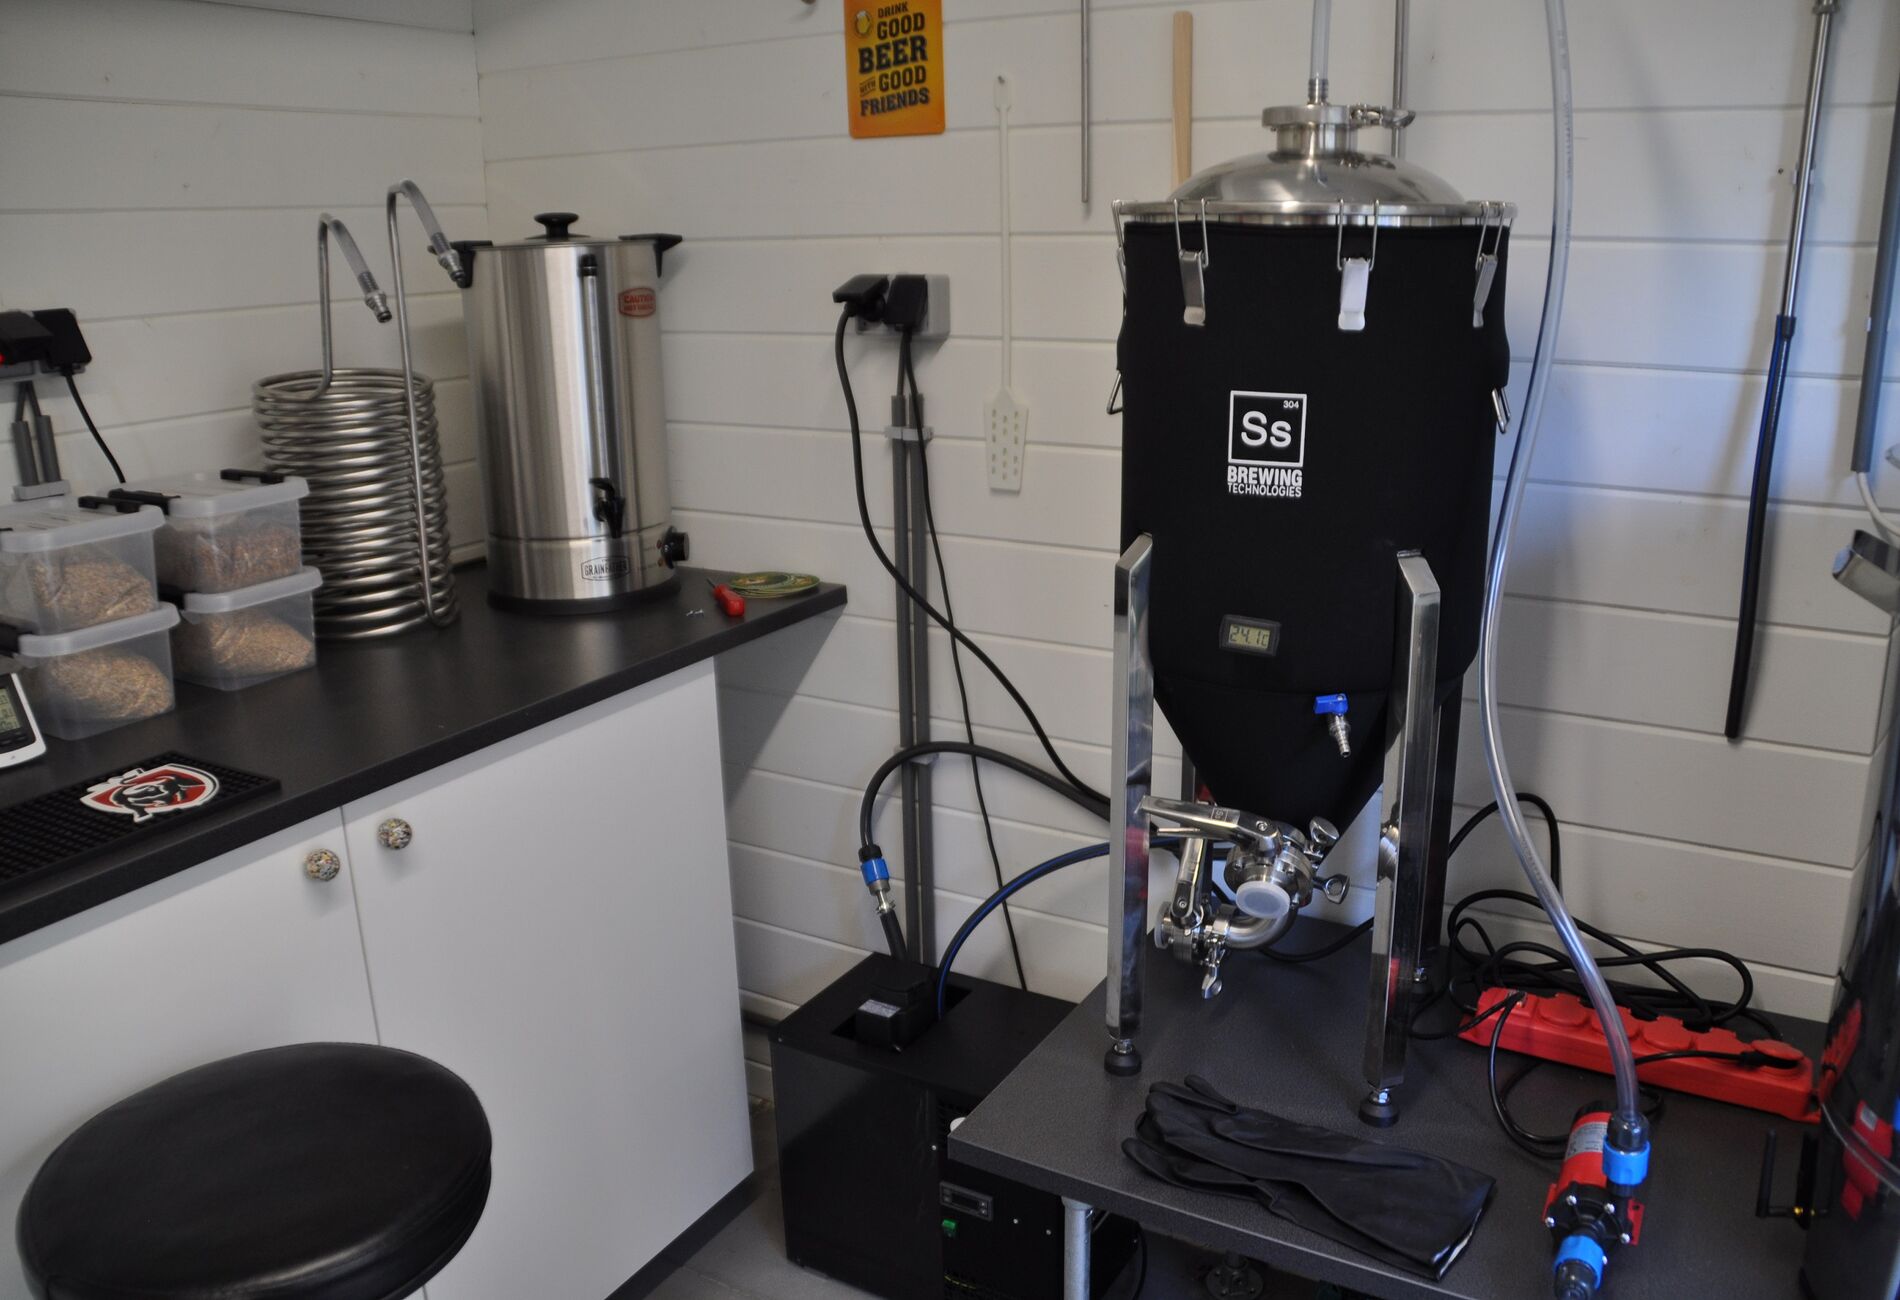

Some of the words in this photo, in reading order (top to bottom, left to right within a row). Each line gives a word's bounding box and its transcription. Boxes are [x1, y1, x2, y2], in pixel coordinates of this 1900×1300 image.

[878, 2, 908, 18] DRINK
[877, 12, 925, 40] GOOD
[858, 35, 928, 74] BEER
[878, 65, 926, 92] GOOD
[860, 87, 929, 117] FRIENDS
[1283, 400, 1299, 409] 304
[1241, 410, 1292, 448] Ss
[1227, 465, 1303, 487] BREWING
[1227, 482, 1302, 498] TECHNOLOGIES
[584, 560, 627, 576] GRAINF
